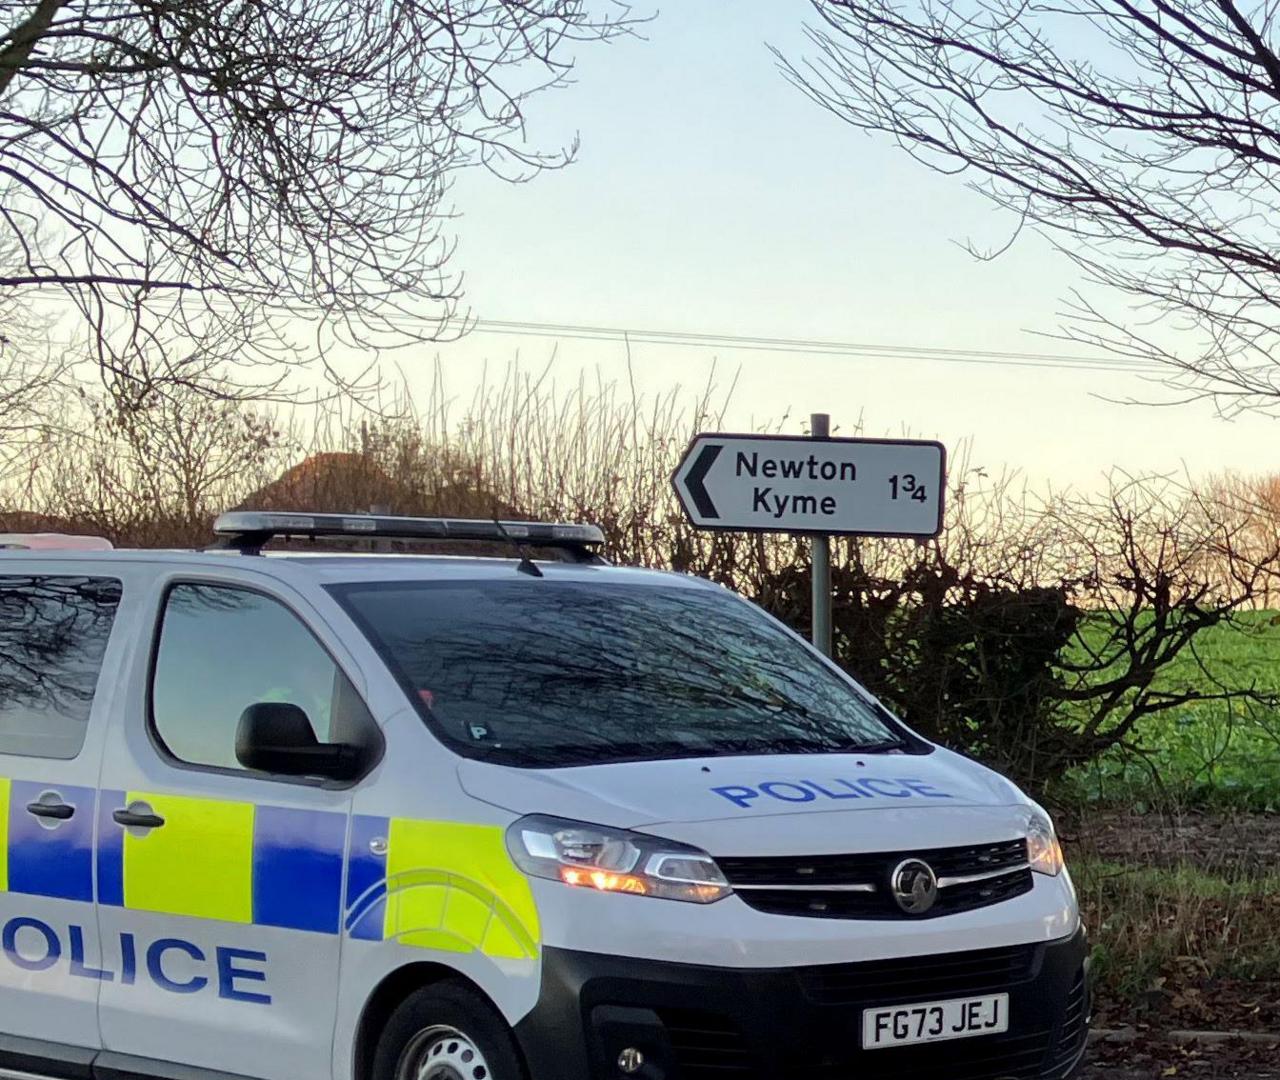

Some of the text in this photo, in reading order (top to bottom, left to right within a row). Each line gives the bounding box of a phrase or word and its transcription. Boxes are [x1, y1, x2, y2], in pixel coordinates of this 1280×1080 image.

[736, 452, 856, 481] Newton
[753, 487, 836, 518] Kyme
[711, 778, 953, 808] POLICE
[1, 916, 272, 1005] OLICE
[875, 999, 998, 1042] FG73 JEJ
